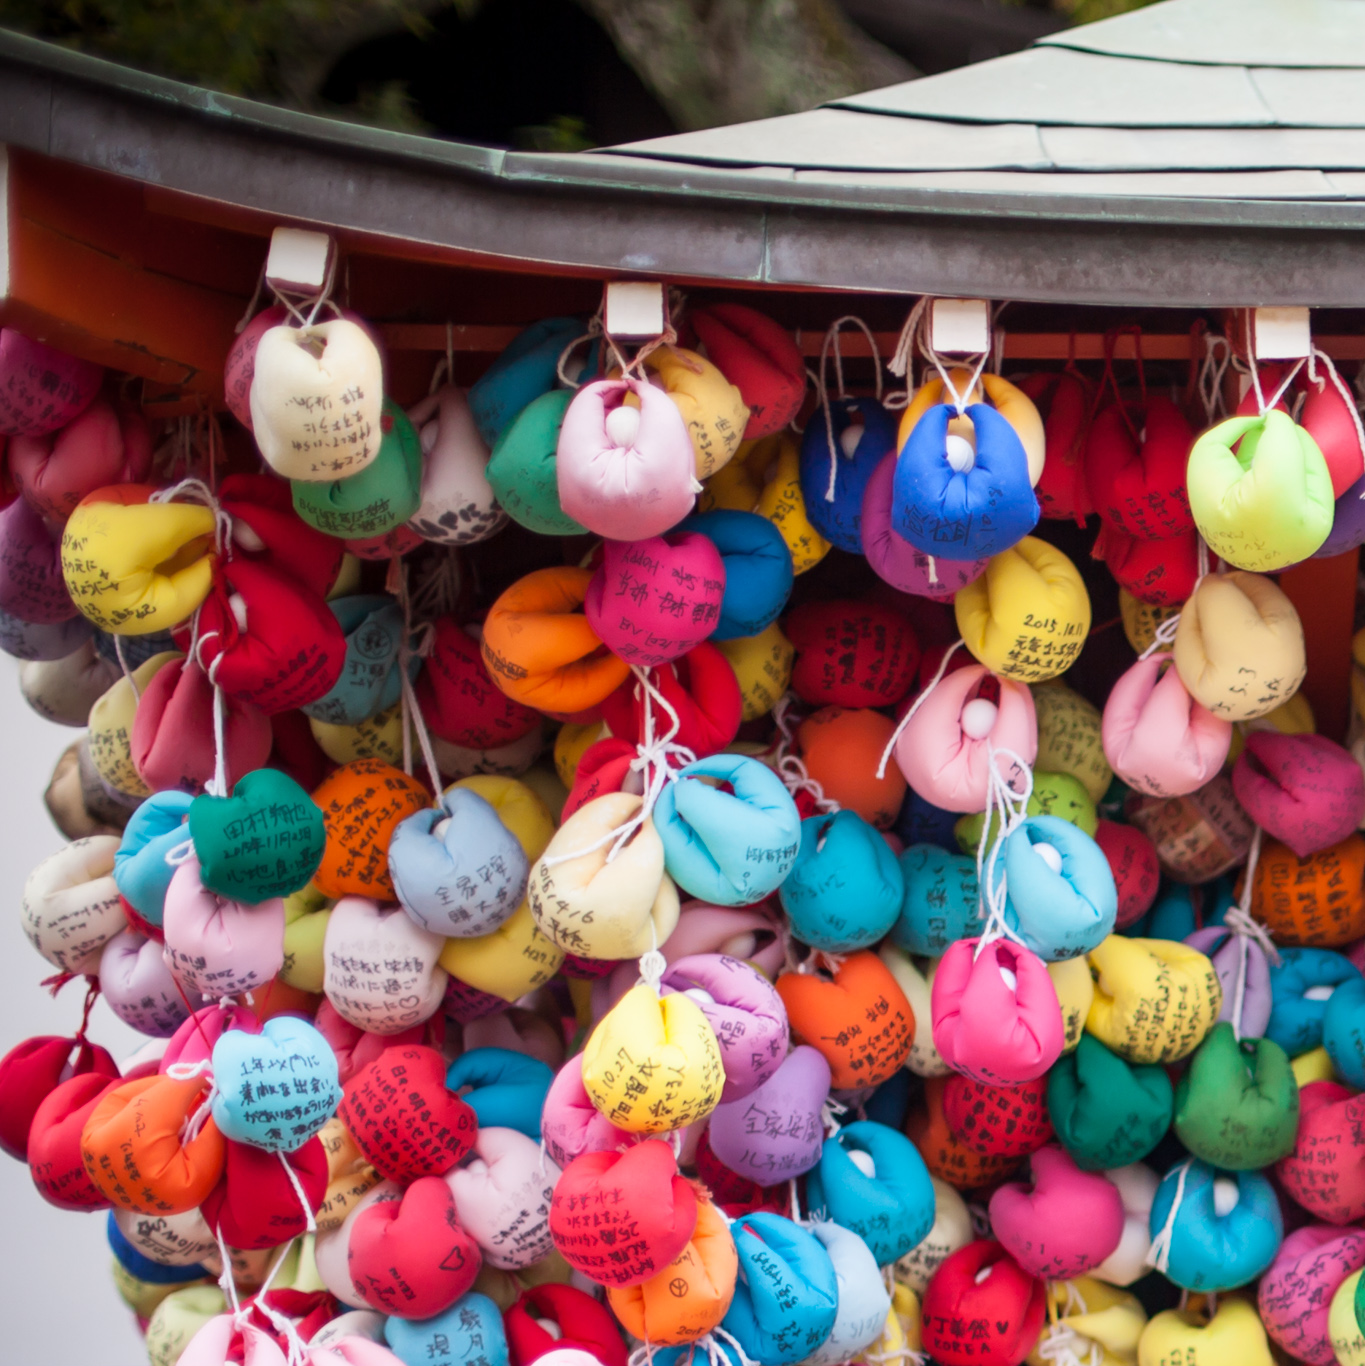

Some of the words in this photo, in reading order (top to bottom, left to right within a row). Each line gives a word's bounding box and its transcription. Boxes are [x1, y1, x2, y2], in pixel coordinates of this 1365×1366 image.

[433, 855, 507, 906] 全家平安
[934, 1337, 991, 1355] KOREA
